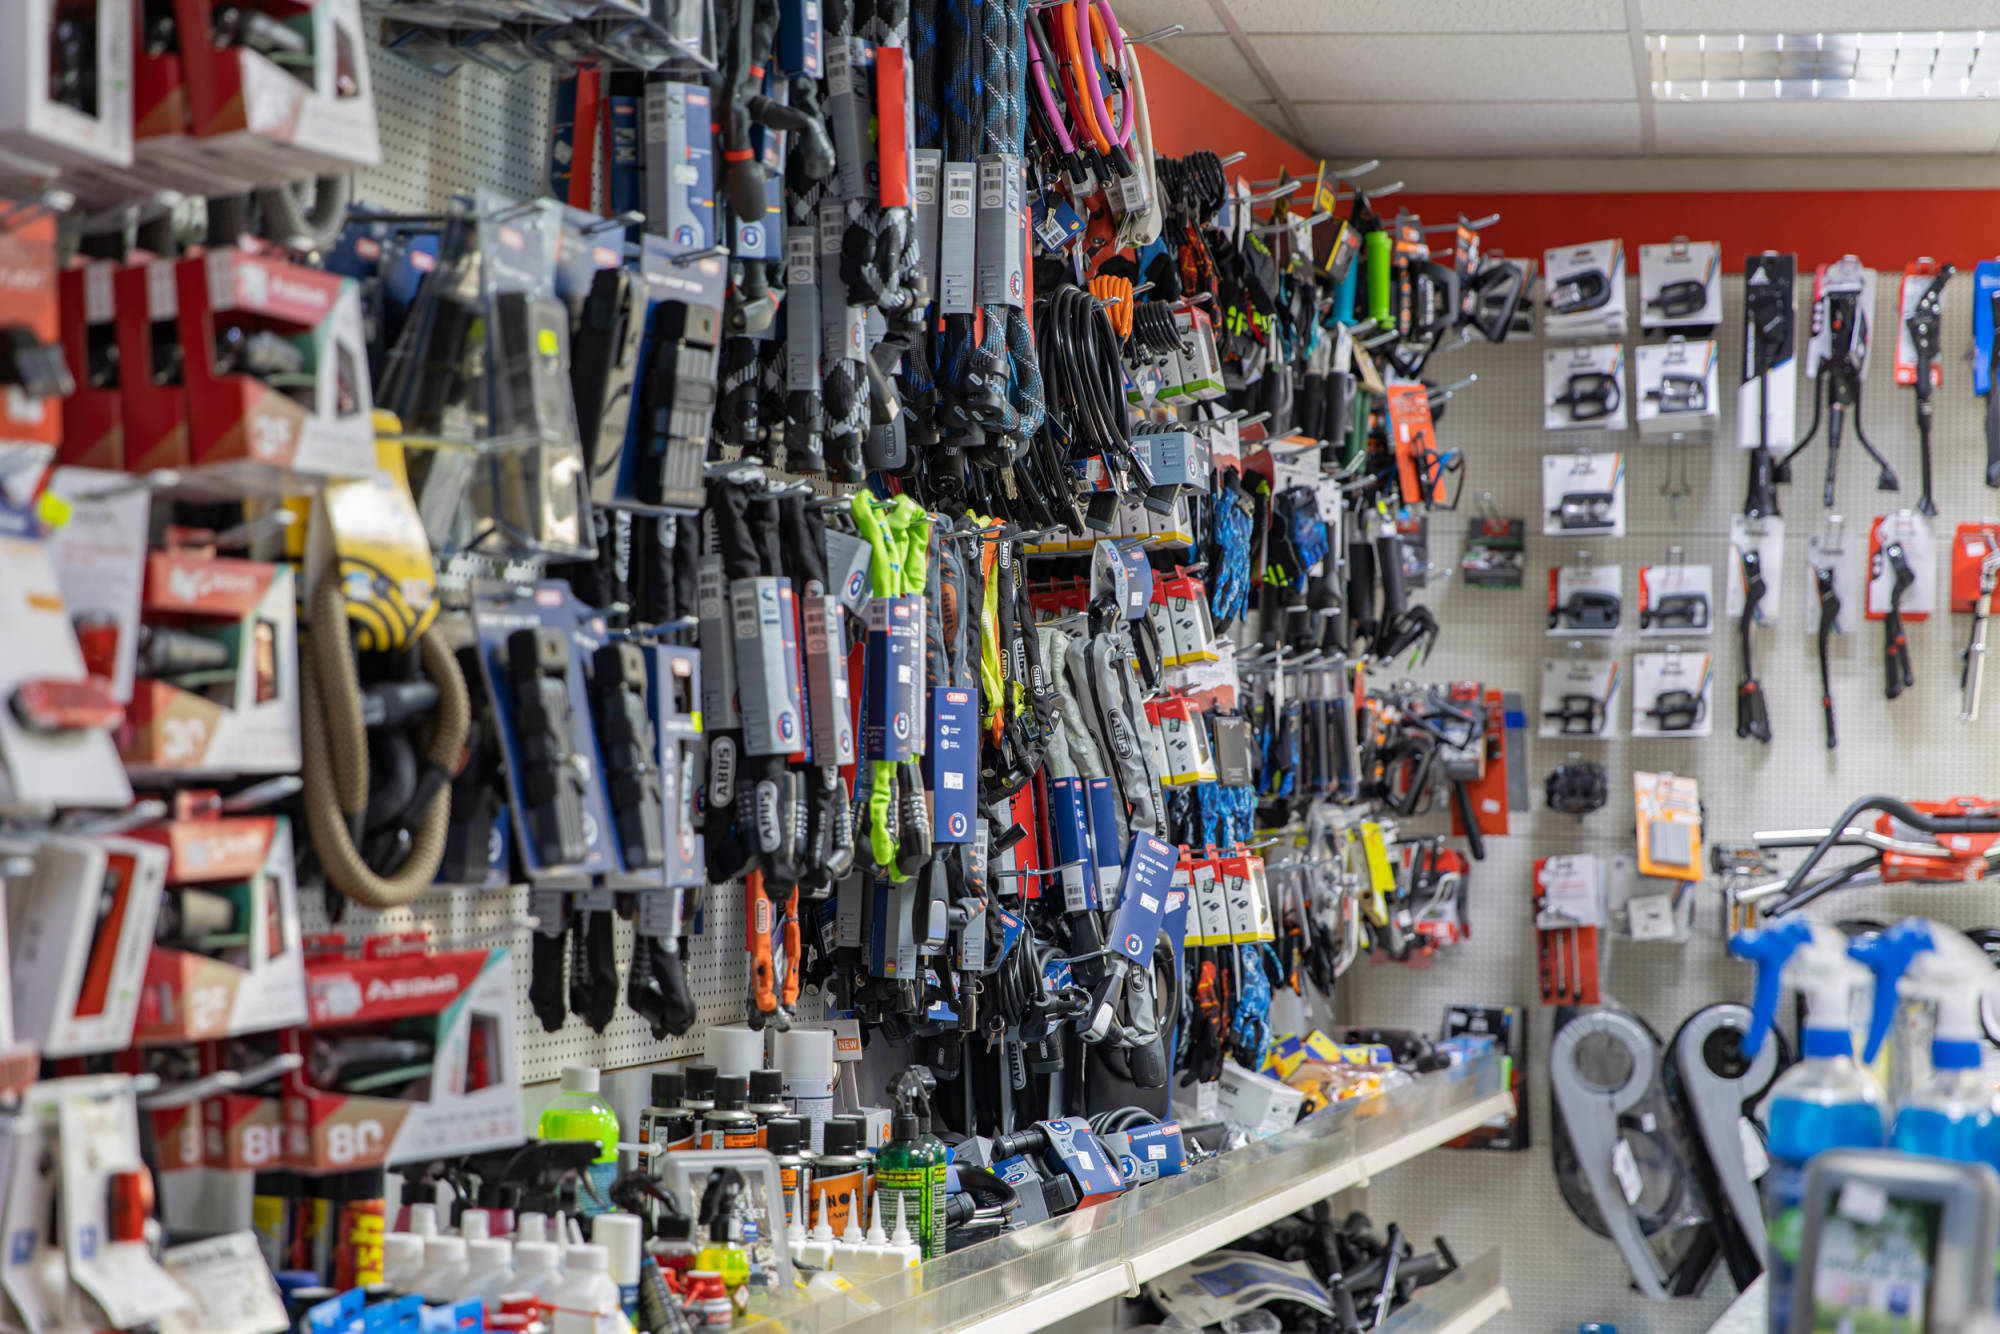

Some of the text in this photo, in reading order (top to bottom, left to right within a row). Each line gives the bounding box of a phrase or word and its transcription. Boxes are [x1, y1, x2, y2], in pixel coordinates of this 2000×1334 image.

[1033, 668, 1042, 691] ABUS
[1111, 717, 1130, 753] ABUS
[717, 748, 729, 797] ABUS
[955, 820, 961, 829] 6
[1131, 941, 1137, 949] 6
[838, 1040, 857, 1049] NEW
